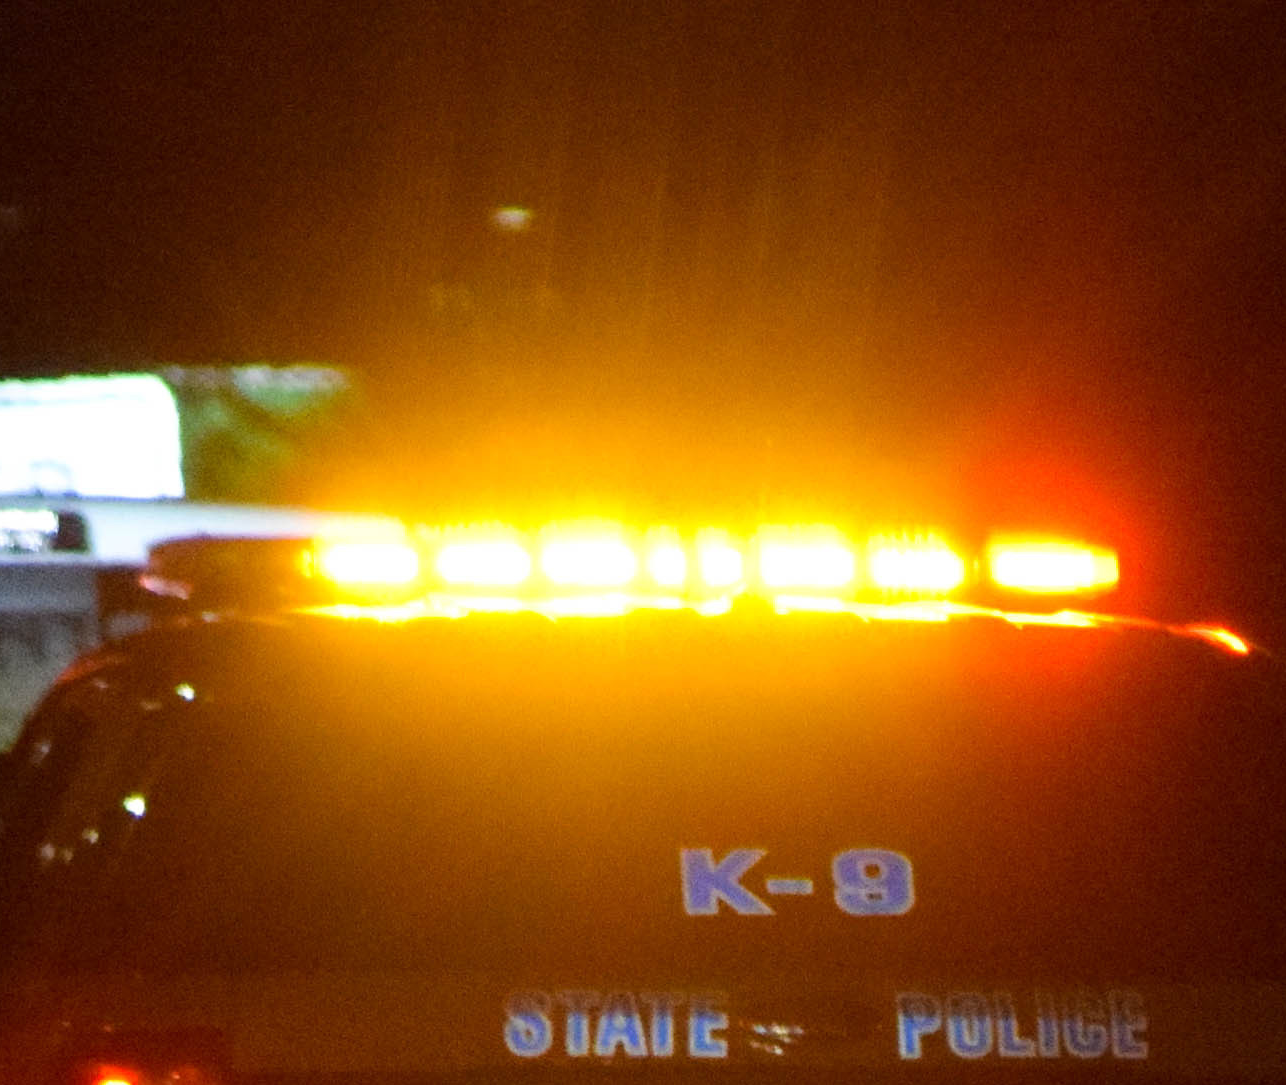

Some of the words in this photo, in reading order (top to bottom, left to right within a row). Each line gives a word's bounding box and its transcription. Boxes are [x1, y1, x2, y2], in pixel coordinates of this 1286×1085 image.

[679, 847, 915, 916] K-9
[504, 990, 729, 1059] STATE
[896, 990, 1149, 1060] POLICE
